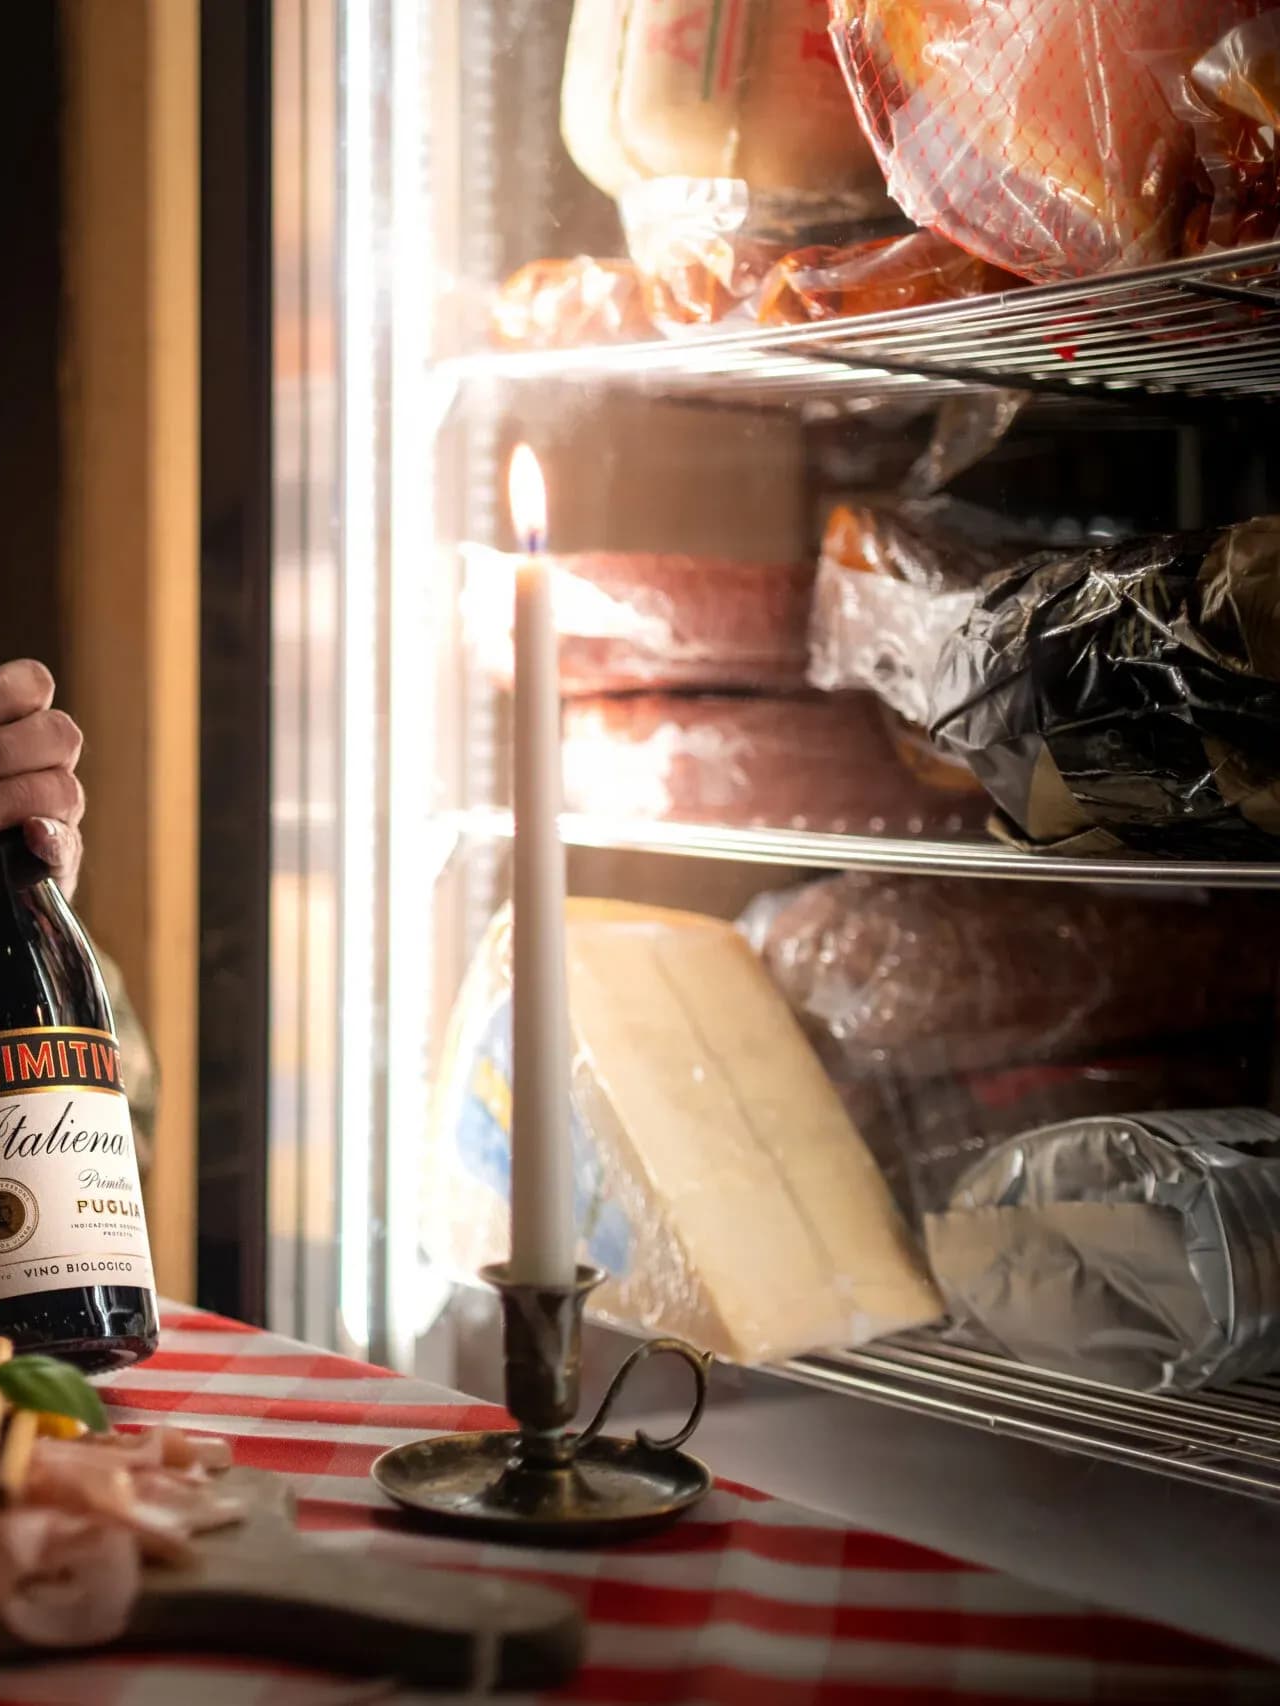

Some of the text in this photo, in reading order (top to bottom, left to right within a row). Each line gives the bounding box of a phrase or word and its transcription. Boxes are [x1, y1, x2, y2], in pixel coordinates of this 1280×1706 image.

[77, 1199, 140, 1218] PUGLIA
[24, 1265, 60, 1279] VINO
[67, 1261, 133, 1273] BIOLOGICO
